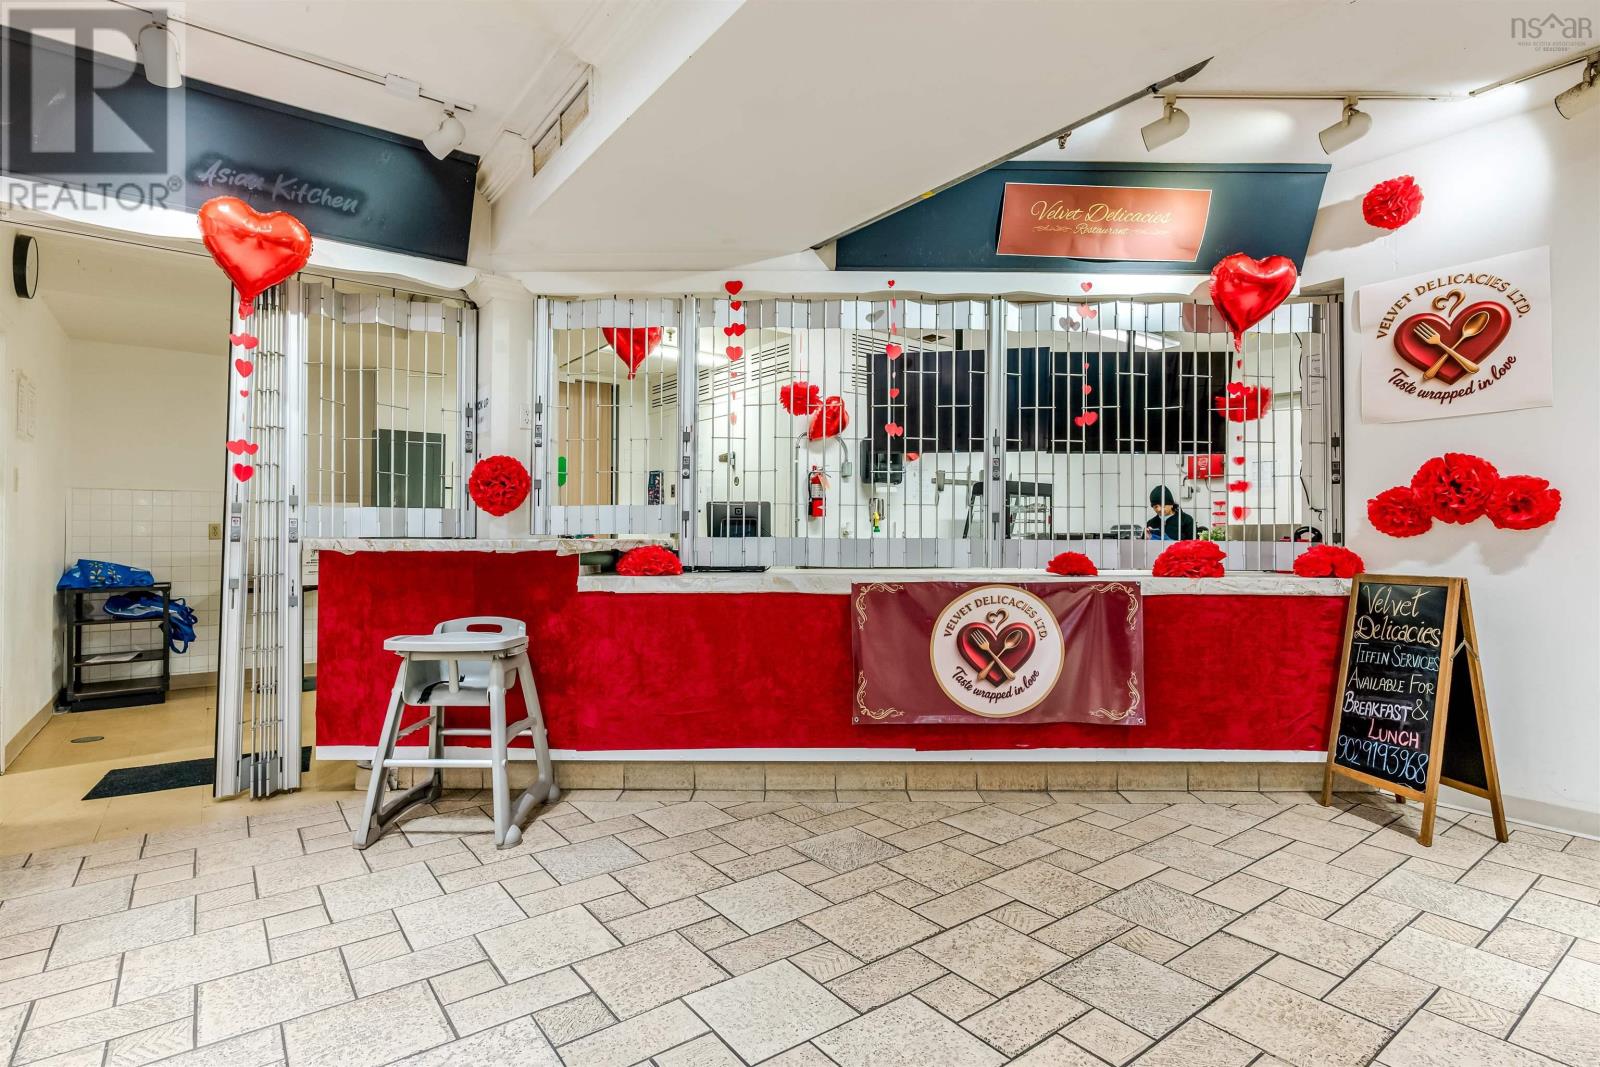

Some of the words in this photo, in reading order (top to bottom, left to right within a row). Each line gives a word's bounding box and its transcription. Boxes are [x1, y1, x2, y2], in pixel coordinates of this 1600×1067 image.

[197, 159, 265, 191] Asian
[1030, 200, 1084, 221] Velvet
[1085, 203, 1173, 224] Delicacies
[1376, 293, 1413, 339] VELVET
[1414, 273, 1511, 297] DELICACIES
[1506, 289, 1532, 318] LTD.
[1387, 367, 1417, 395] Taste
[1417, 379, 1476, 405] wrapped
[1478, 375, 1494, 391] in
[1491, 355, 1517, 380] love
[1363, 584, 1431, 618] Velvet
[943, 603, 973, 637] VELVET
[974, 595, 1039, 619] DELICACIES
[1035, 617, 1048, 641] LTD.
[1353, 614, 1441, 648] Delicacies
[1354, 642, 1390, 665] TIFFIN
[1391, 645, 1440, 671] SERVICES
[952, 666, 973, 692] Taste
[973, 687, 1014, 704] wrapped
[1014, 683, 1025, 696] in
[1023, 669, 1040, 690] love
[1347, 666, 1404, 694] AVAILABLE
[1409, 674, 1435, 695] FOR
[1343, 691, 1413, 722] BREAKFAST
[1412, 698, 1429, 721] &
[1368, 718, 1420, 749] LUNCH
